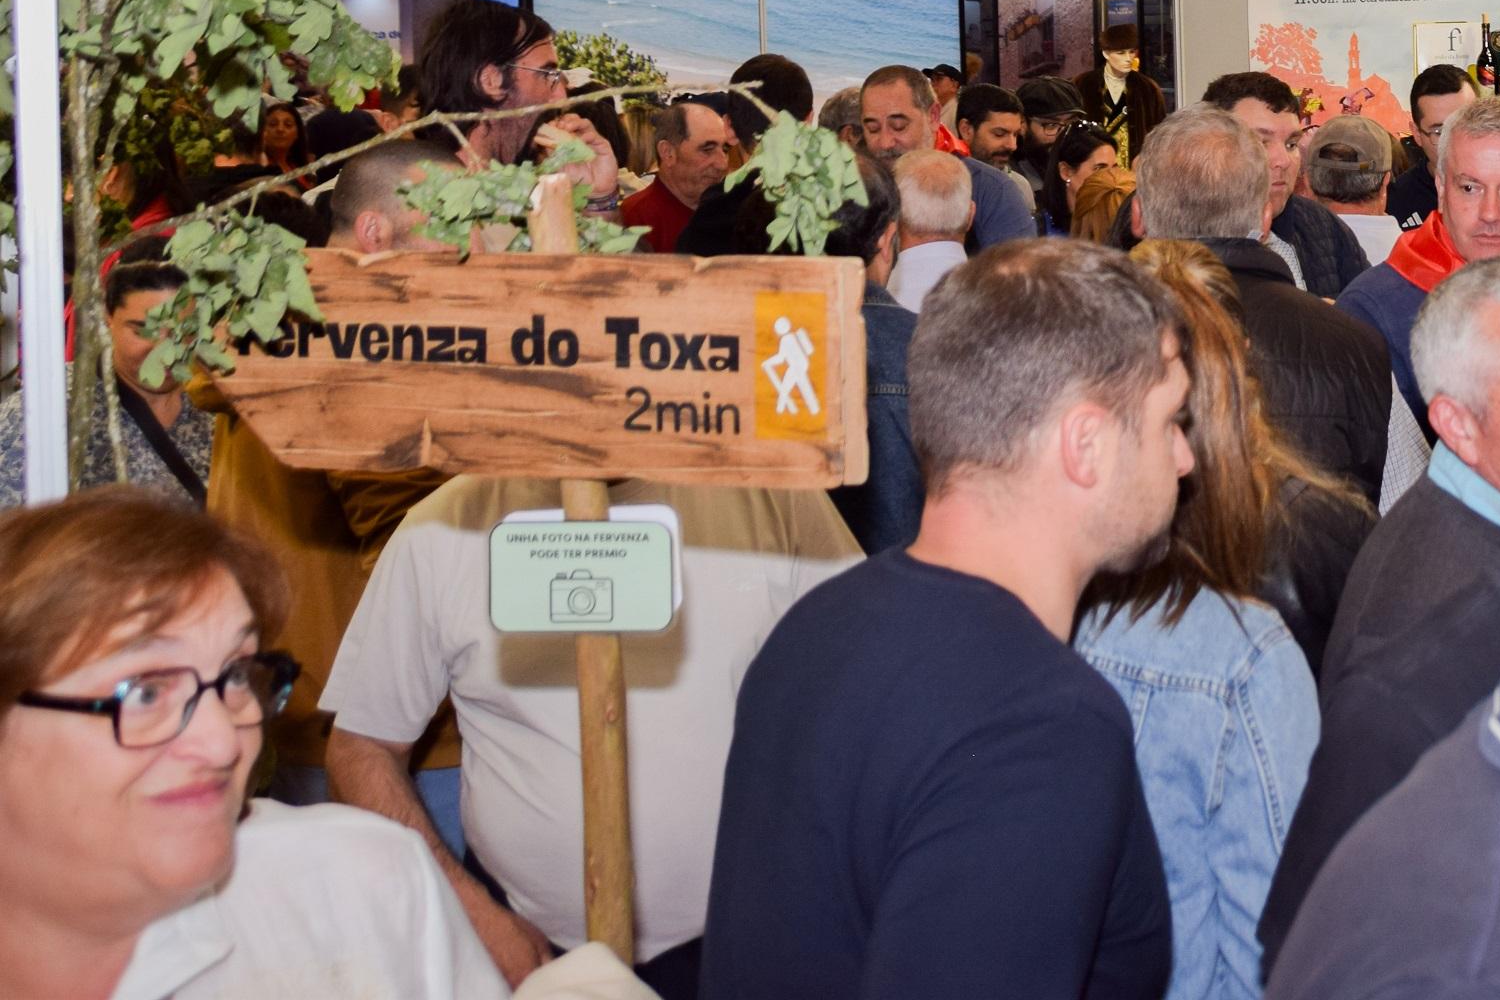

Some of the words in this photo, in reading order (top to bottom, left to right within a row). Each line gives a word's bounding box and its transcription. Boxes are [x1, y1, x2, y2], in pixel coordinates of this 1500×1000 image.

[510, 315, 579, 367] do
[604, 316, 740, 372] Toxa
[624, 387, 740, 435] 2min
[507, 534, 538, 543] UNHA
[542, 534, 571, 542] FOTO
[575, 533, 589, 542] NA
[594, 533, 649, 542] FERVENZA
[530, 550, 559, 558] PODE
[564, 550, 581, 558] TER
[585, 549, 627, 558] PREMIO
